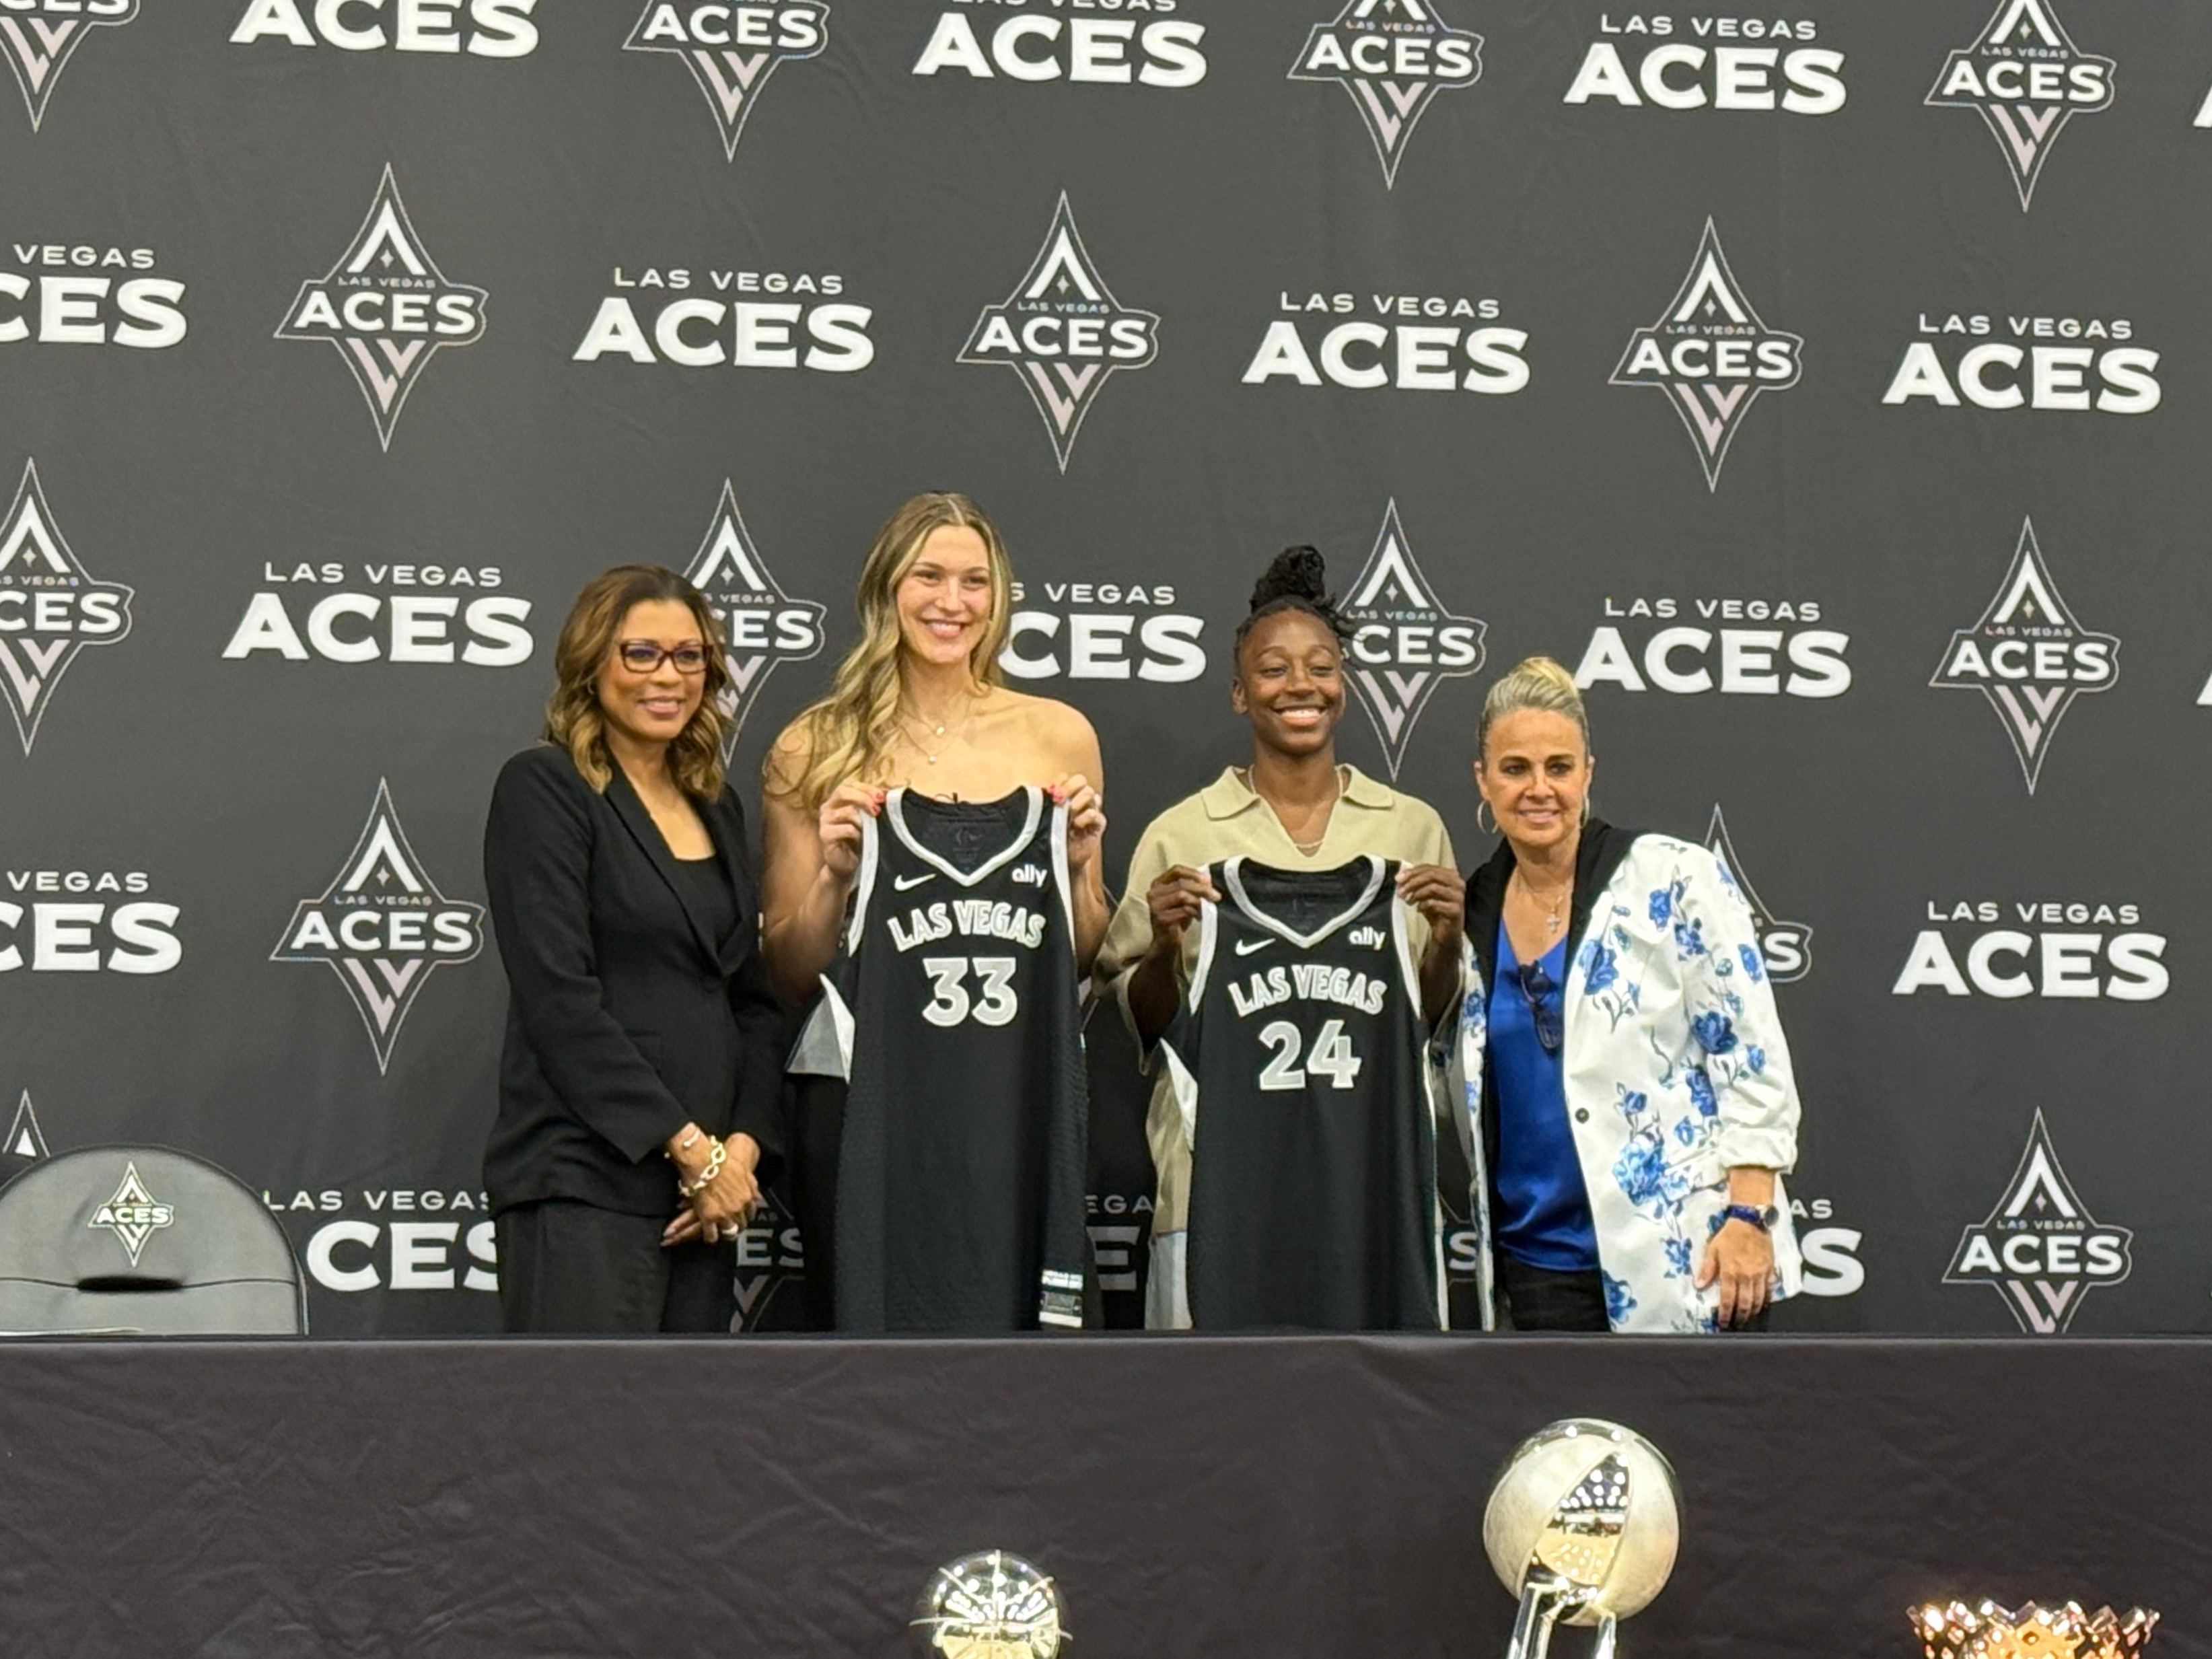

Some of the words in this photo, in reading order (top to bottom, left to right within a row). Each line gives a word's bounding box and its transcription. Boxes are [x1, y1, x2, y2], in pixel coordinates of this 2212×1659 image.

[229, 0, 538, 57] ACES
[643, 4, 818, 48] ACES
[1601, 14, 1673, 35] LAS
[1691, 17, 1816, 40] VEGAS
[913, 12, 1207, 87] ACES
[1306, 34, 1472, 77] ACES
[1563, 42, 1846, 114] ACES
[1942, 60, 2105, 102] ACES
[13, 244, 154, 269] VEGAS
[614, 267, 690, 289] LAS
[710, 271, 843, 295] VEGAS
[0, 273, 186, 348] ES
[294, 291, 475, 334] ACES
[1281, 291, 1354, 313] LAS
[1373, 295, 1499, 319] VEGAS
[573, 297, 874, 372] ACES
[976, 316, 1148, 358] ACES
[1919, 314, 1991, 334] LAS
[2009, 316, 2132, 339] VEGAS
[1242, 321, 1530, 394] ACES
[1627, 339, 1792, 379] ACES
[1882, 343, 2161, 413] ACES
[265, 562, 344, 583] LAS
[365, 564, 501, 587] VEGAS
[1044, 583, 1175, 605] VEGAS
[0, 590, 121, 633] CES
[222, 592, 534, 666] ACES
[733, 610, 815, 649] ES
[1605, 598, 1677, 618] LAS
[1696, 599, 1820, 622] VEGAS
[998, 611, 1207, 682] CES
[1353, 625, 1476, 665] CES
[1575, 627, 1852, 698] ACES
[1948, 640, 2110, 681] ACES
[7, 871, 148, 892] VEGAS
[1011, 863, 1047, 888] ally
[291, 910, 472, 952] ACES
[887, 903, 952, 952] LAS
[952, 900, 1046, 948] VEGAS
[1928, 901, 1999, 922] LAS
[2016, 903, 2139, 925] VEGAS
[0, 901, 182, 974] ES
[1349, 926, 1386, 950] ally
[1892, 930, 2169, 1000] ACES
[922, 957, 1018, 1026] 33
[1227, 966, 1291, 1017] LAS
[1291, 964, 1388, 1015] VEGAS
[1258, 1020, 1362, 1090] 24
[96, 1207, 168, 1224] ACES
[263, 1191, 342, 1211] LAS
[1085, 1195, 1153, 1214] EGA
[307, 1220, 499, 1292] CES
[737, 1228, 805, 1267] ES
[1959, 1234, 2122, 1275] ACES
